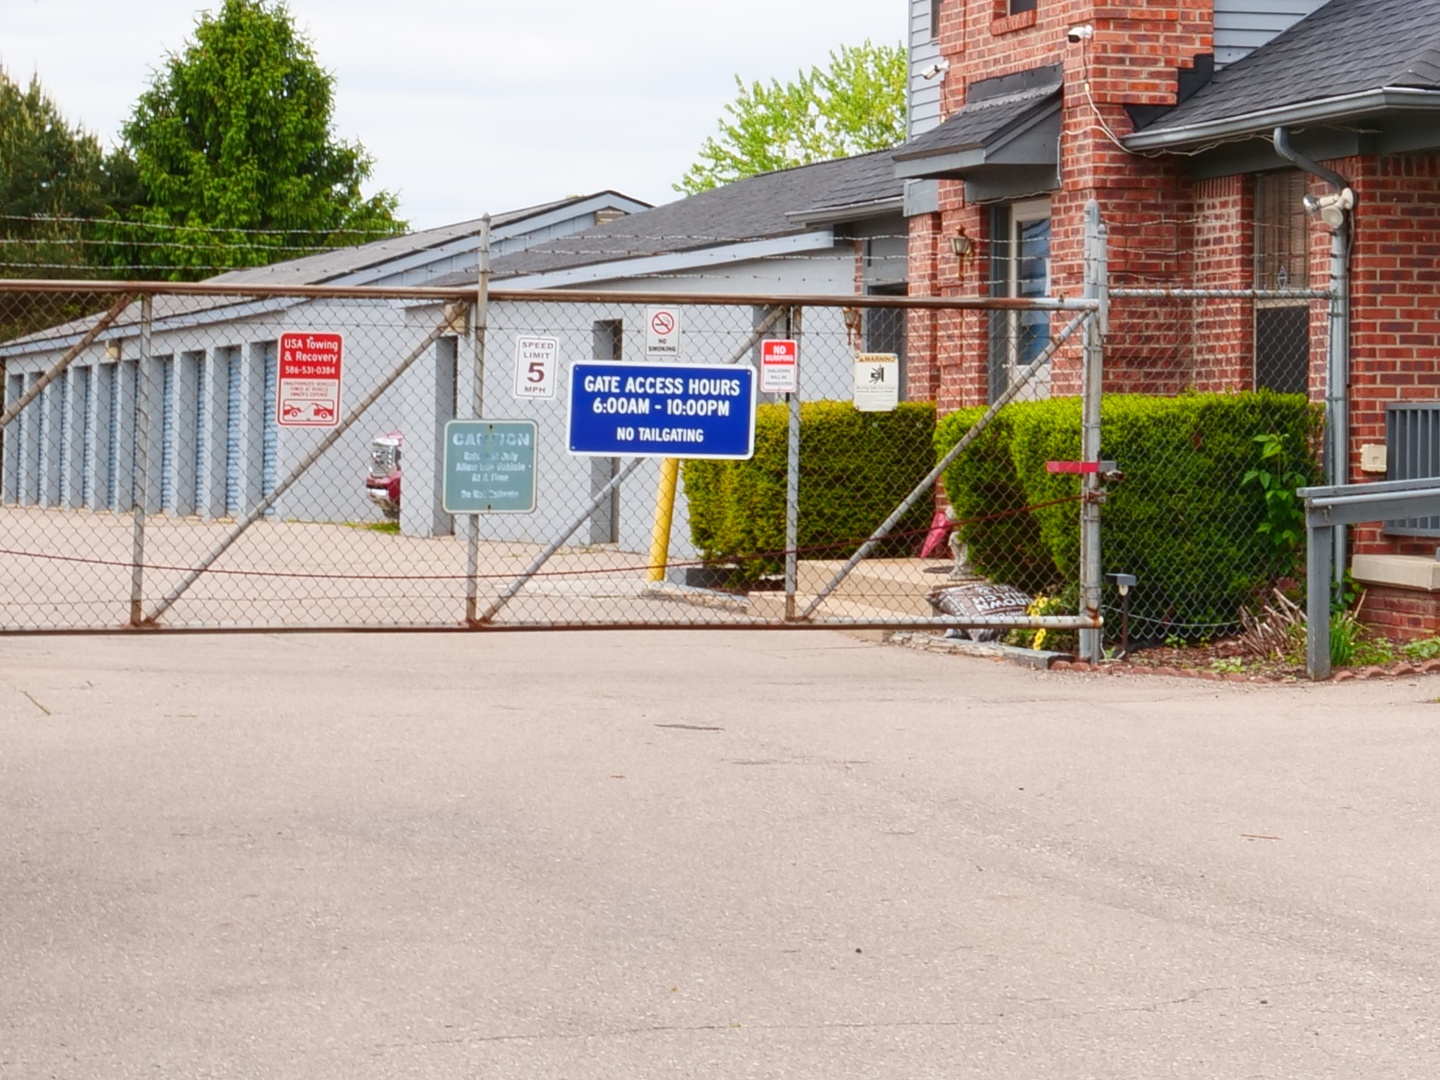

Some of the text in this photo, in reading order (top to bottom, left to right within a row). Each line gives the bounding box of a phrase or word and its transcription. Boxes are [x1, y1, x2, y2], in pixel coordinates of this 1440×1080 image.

[284, 338, 338, 352] USA Towing
[773, 345, 787, 355] NO
[284, 351, 338, 364] & Recovery
[285, 365, 336, 374] 586-531-0384
[527, 362, 545, 383] 5
[584, 375, 740, 396] GATE ACCESS HOURS
[593, 396, 649, 414] 6:00AM
[667, 398, 730, 416] 10:00PM
[616, 426, 704, 443] NO TAILGATING
